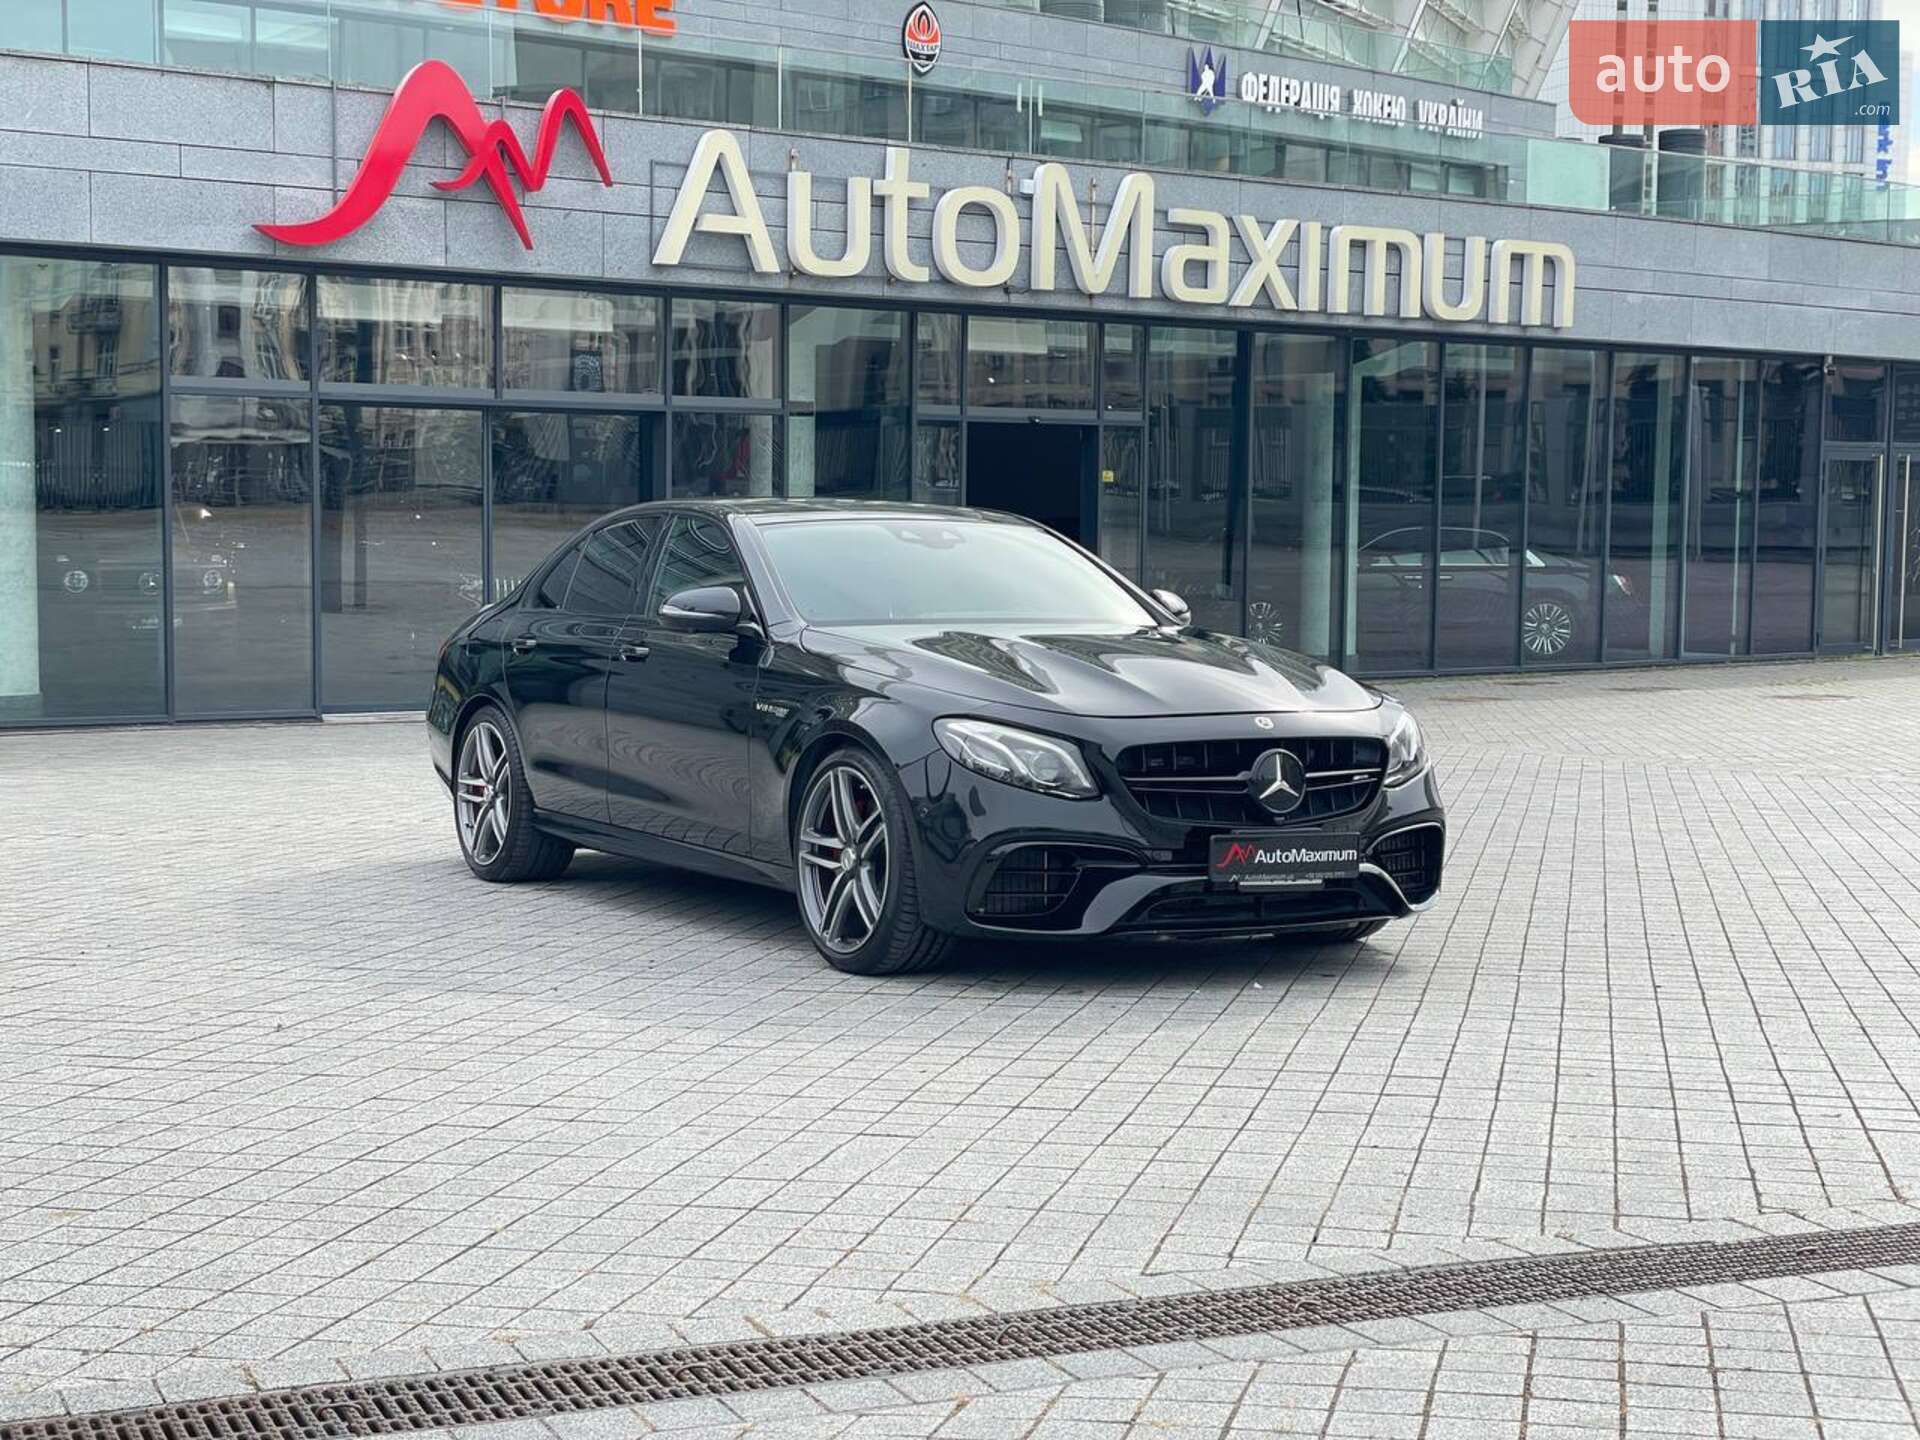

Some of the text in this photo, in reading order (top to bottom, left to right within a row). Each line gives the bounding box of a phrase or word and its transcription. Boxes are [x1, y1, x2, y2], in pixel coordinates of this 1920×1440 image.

[1240, 71, 1341, 120] ФЕДЕРАЦІЯ
[1352, 89, 1407, 127] ХОКЕЮ
[652, 129, 1577, 328] AutoMaximum
[1254, 848, 1358, 864] AutoMaximum
